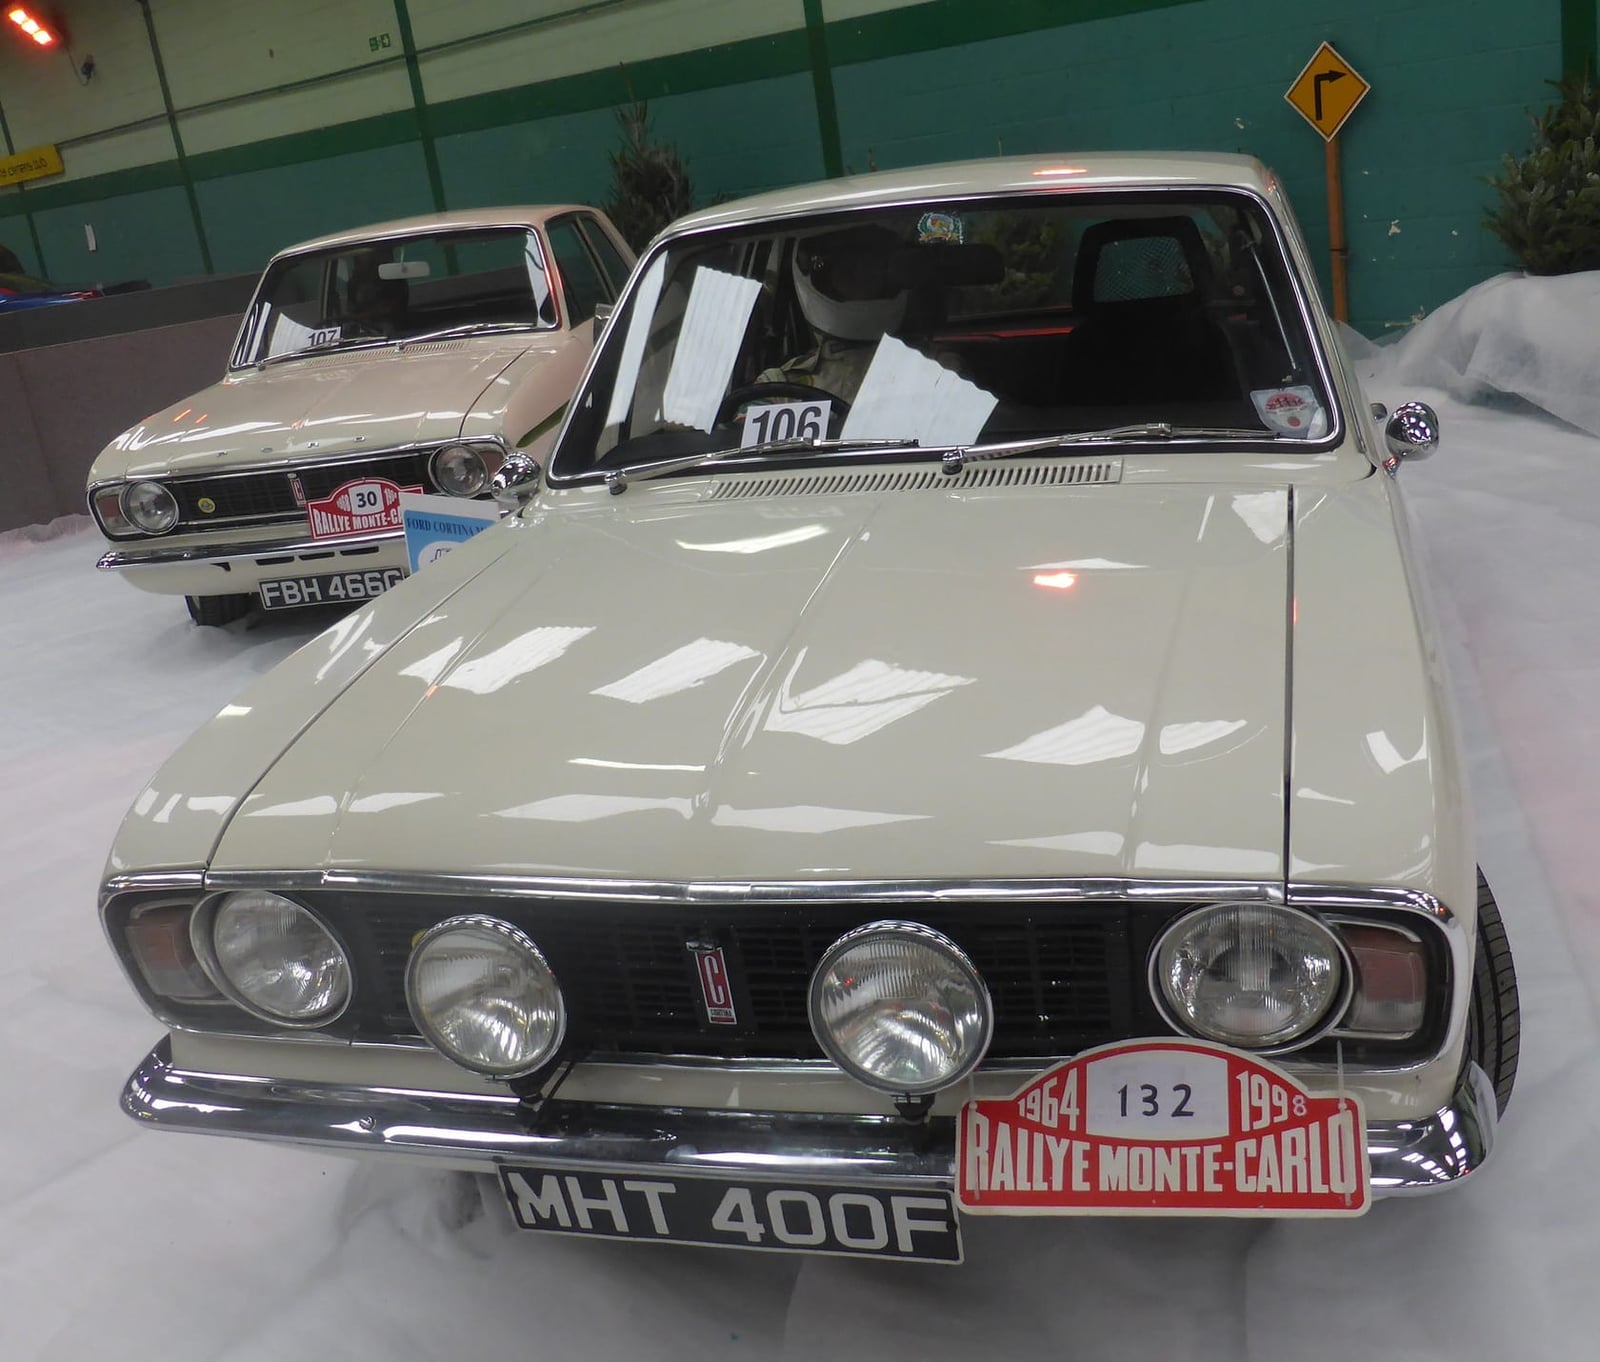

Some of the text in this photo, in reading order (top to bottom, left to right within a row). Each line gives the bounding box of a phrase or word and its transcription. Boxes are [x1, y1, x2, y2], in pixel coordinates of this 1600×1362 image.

[308, 329, 337, 346] 107
[752, 406, 822, 444] 106
[356, 491, 377, 508] 30
[313, 508, 351, 535] RALLYE
[407, 518, 431, 532] FORD
[433, 521, 474, 537] CORTINA
[261, 570, 404, 607] FBH 466G
[704, 955, 725, 1005] C
[1018, 1068, 1080, 1132] 1964
[1117, 1083, 1195, 1117] 132
[1236, 1070, 1308, 1133] 1998
[965, 1110, 1358, 1195] RALLYE MONTE-CARLO
[507, 1172, 949, 1253] MHT 400F
